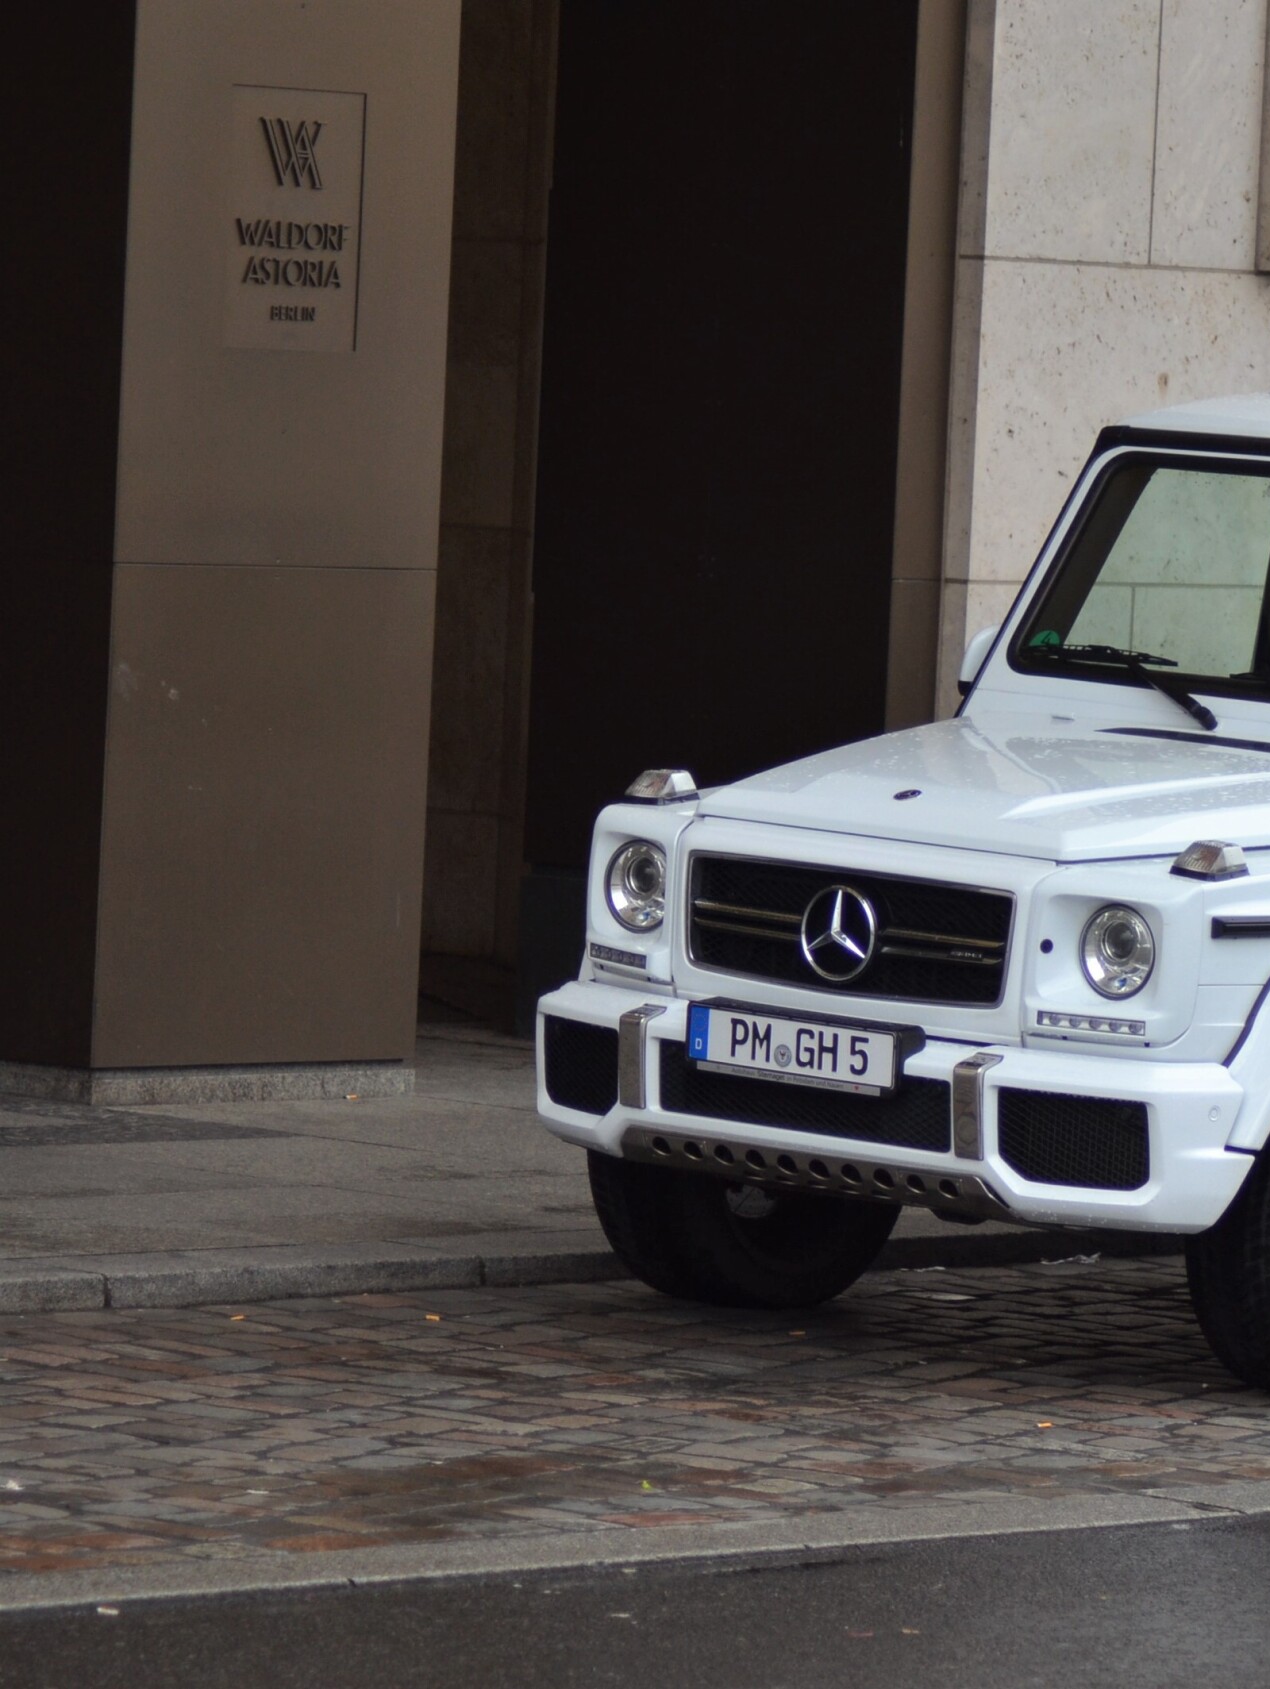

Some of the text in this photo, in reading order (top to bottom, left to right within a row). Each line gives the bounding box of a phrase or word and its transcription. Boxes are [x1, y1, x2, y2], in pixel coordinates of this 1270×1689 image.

[235, 217, 350, 251] WALDORF
[241, 256, 342, 289] ASTORIA
[270, 305, 316, 322] BERLIN
[694, 1037, 703, 1050] D
[730, 1017, 870, 1076] PM GH 5
